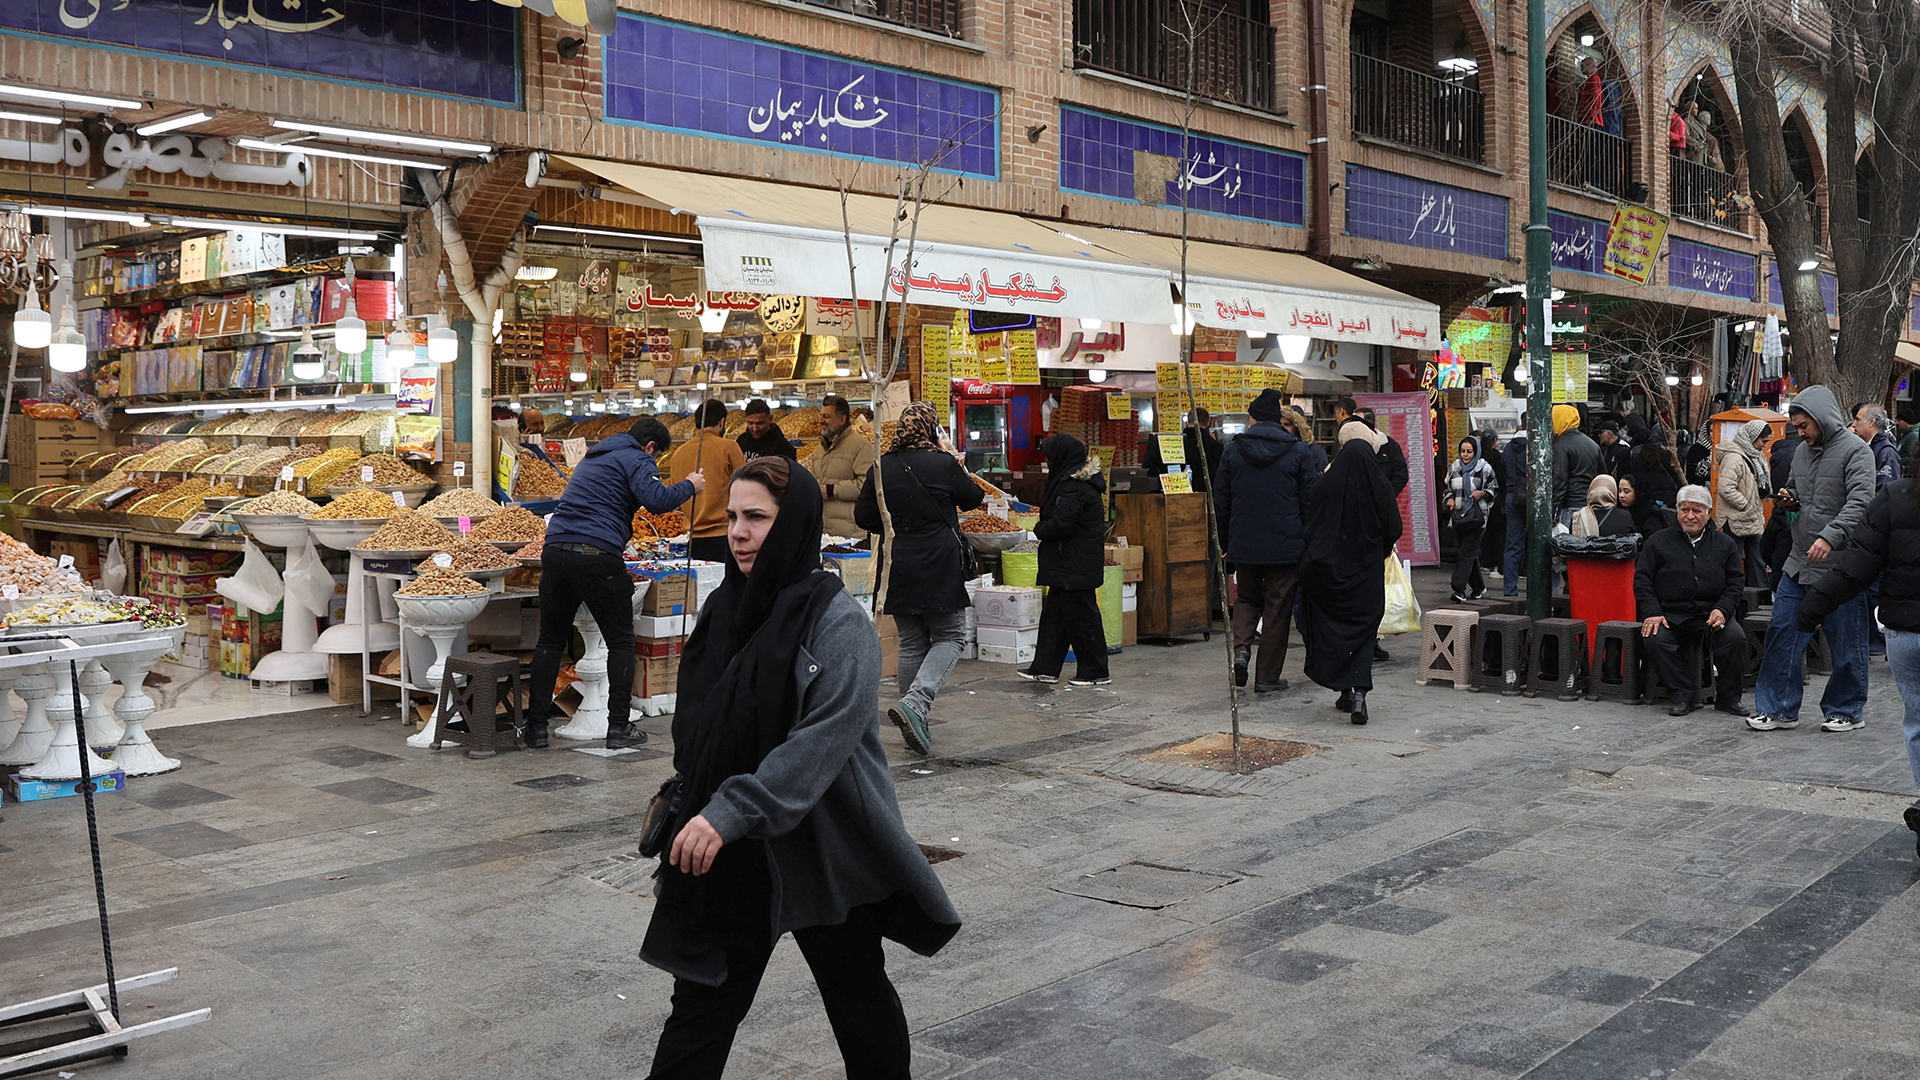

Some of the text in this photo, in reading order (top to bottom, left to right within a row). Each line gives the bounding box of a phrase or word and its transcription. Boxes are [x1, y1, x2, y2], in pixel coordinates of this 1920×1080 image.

[747, 74, 889, 142] خشکبار پیمان
[0, 127, 313, 191] معصوم
[1177, 151, 1243, 199] فروشگاه
[1433, 195, 1457, 247] بازار
[1567, 226, 1594, 261] فروشگاه
[889, 259, 1068, 306] خشکبار پیمان
[626, 284, 761, 320] خشکبار پیمان
[1214, 296, 1267, 322] ساندویچ
[1289, 305, 1334, 331] انفجار
[978, 334, 1001, 352] صندوق
[1062, 322, 1125, 363] امیر
[1337, 316, 1372, 336] امیر
[1391, 315, 1429, 344] پیتزا
[967, 382, 994, 395] Coca-Cola
